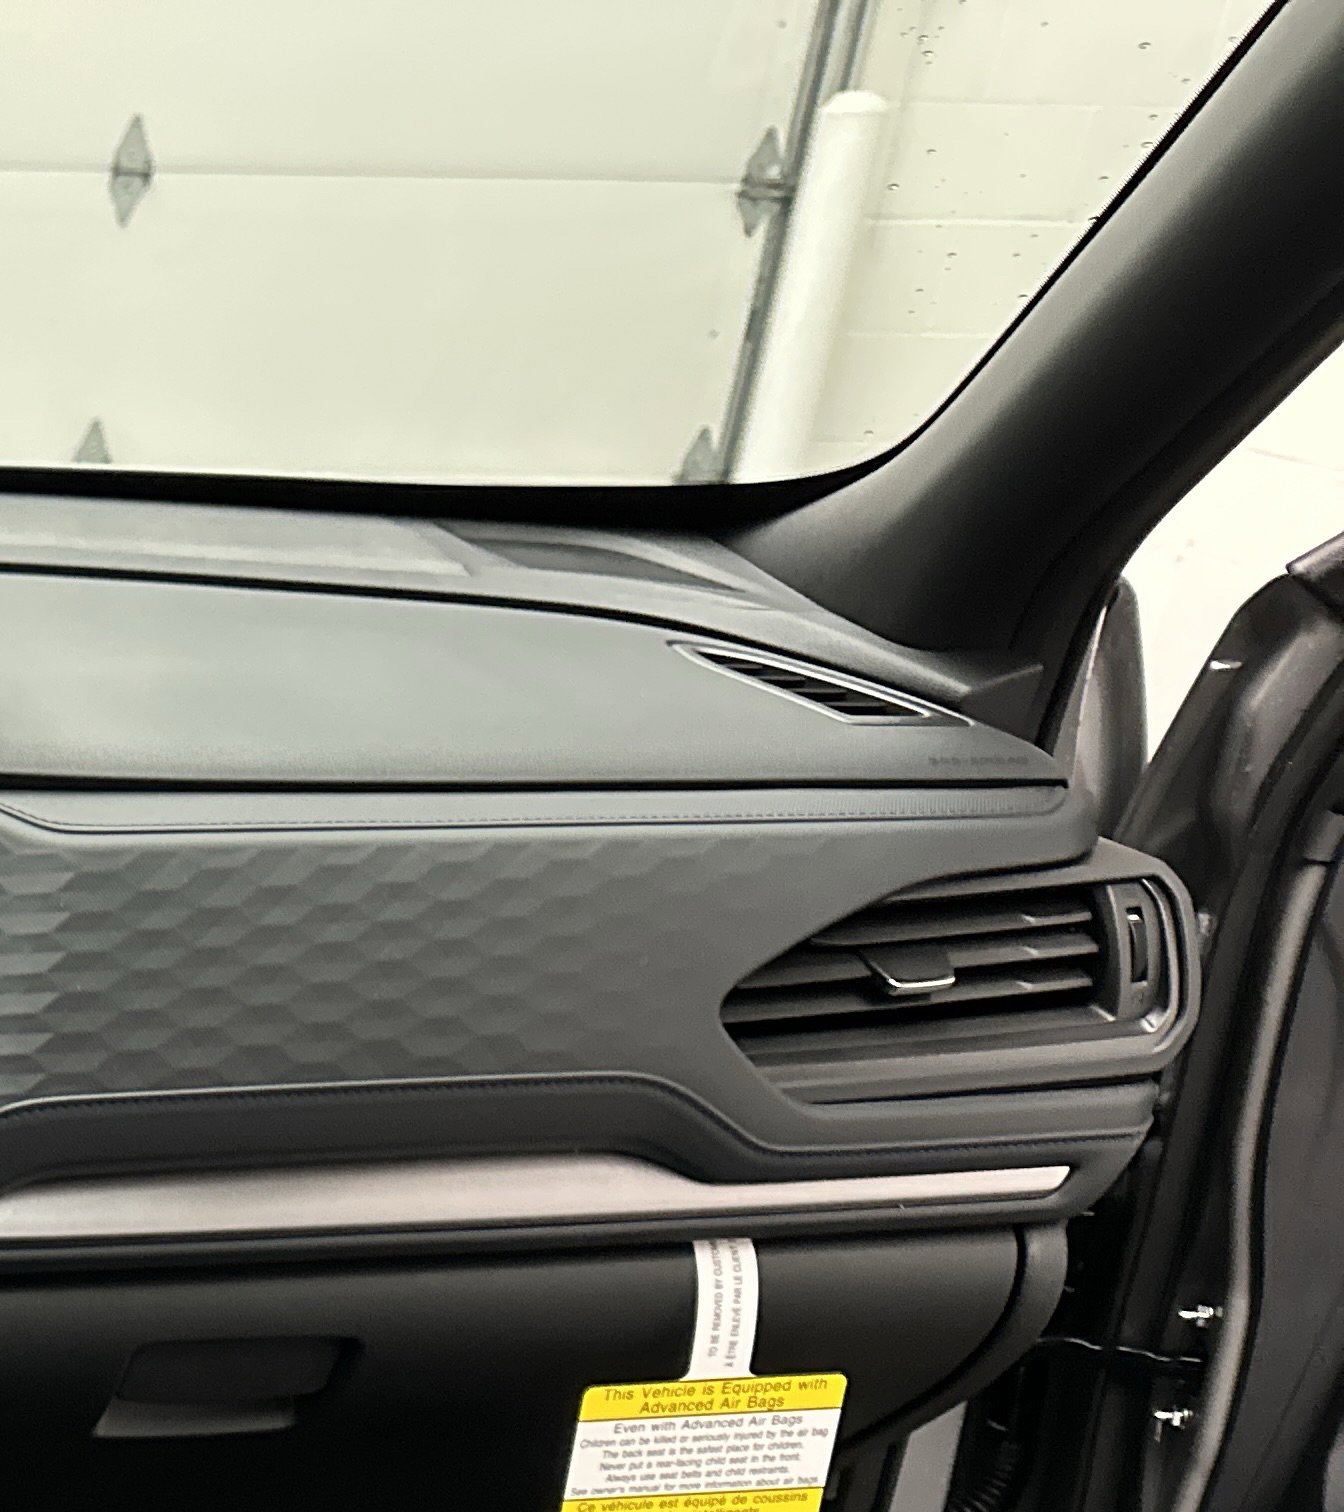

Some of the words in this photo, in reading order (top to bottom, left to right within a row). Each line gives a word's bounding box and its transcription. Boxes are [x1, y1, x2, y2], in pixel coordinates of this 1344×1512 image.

[712, 1292, 723, 1331] REMOVED
[710, 1334, 720, 1344] BE
[604, 1388, 634, 1401] This
[642, 1385, 696, 1399] Vehicle
[702, 1383, 715, 1396] is
[722, 1380, 792, 1396] Equipped
[799, 1378, 828, 1390] with
[639, 1398, 714, 1414] Advanced
[720, 1397, 741, 1410] Air
[747, 1395, 785, 1412] Bags
[614, 1423, 646, 1434] Even
[651, 1421, 676, 1432] with
[681, 1417, 744, 1430] Advanced
[749, 1416, 767, 1427] Air
[772, 1415, 803, 1427] Bags
[601, 1500, 654, 1512] véhicule
[659, 1499, 680, 1510] est
[684, 1495, 727, 1509] équipé
[731, 1495, 748, 1505] de
[752, 1492, 808, 1505] coussins
